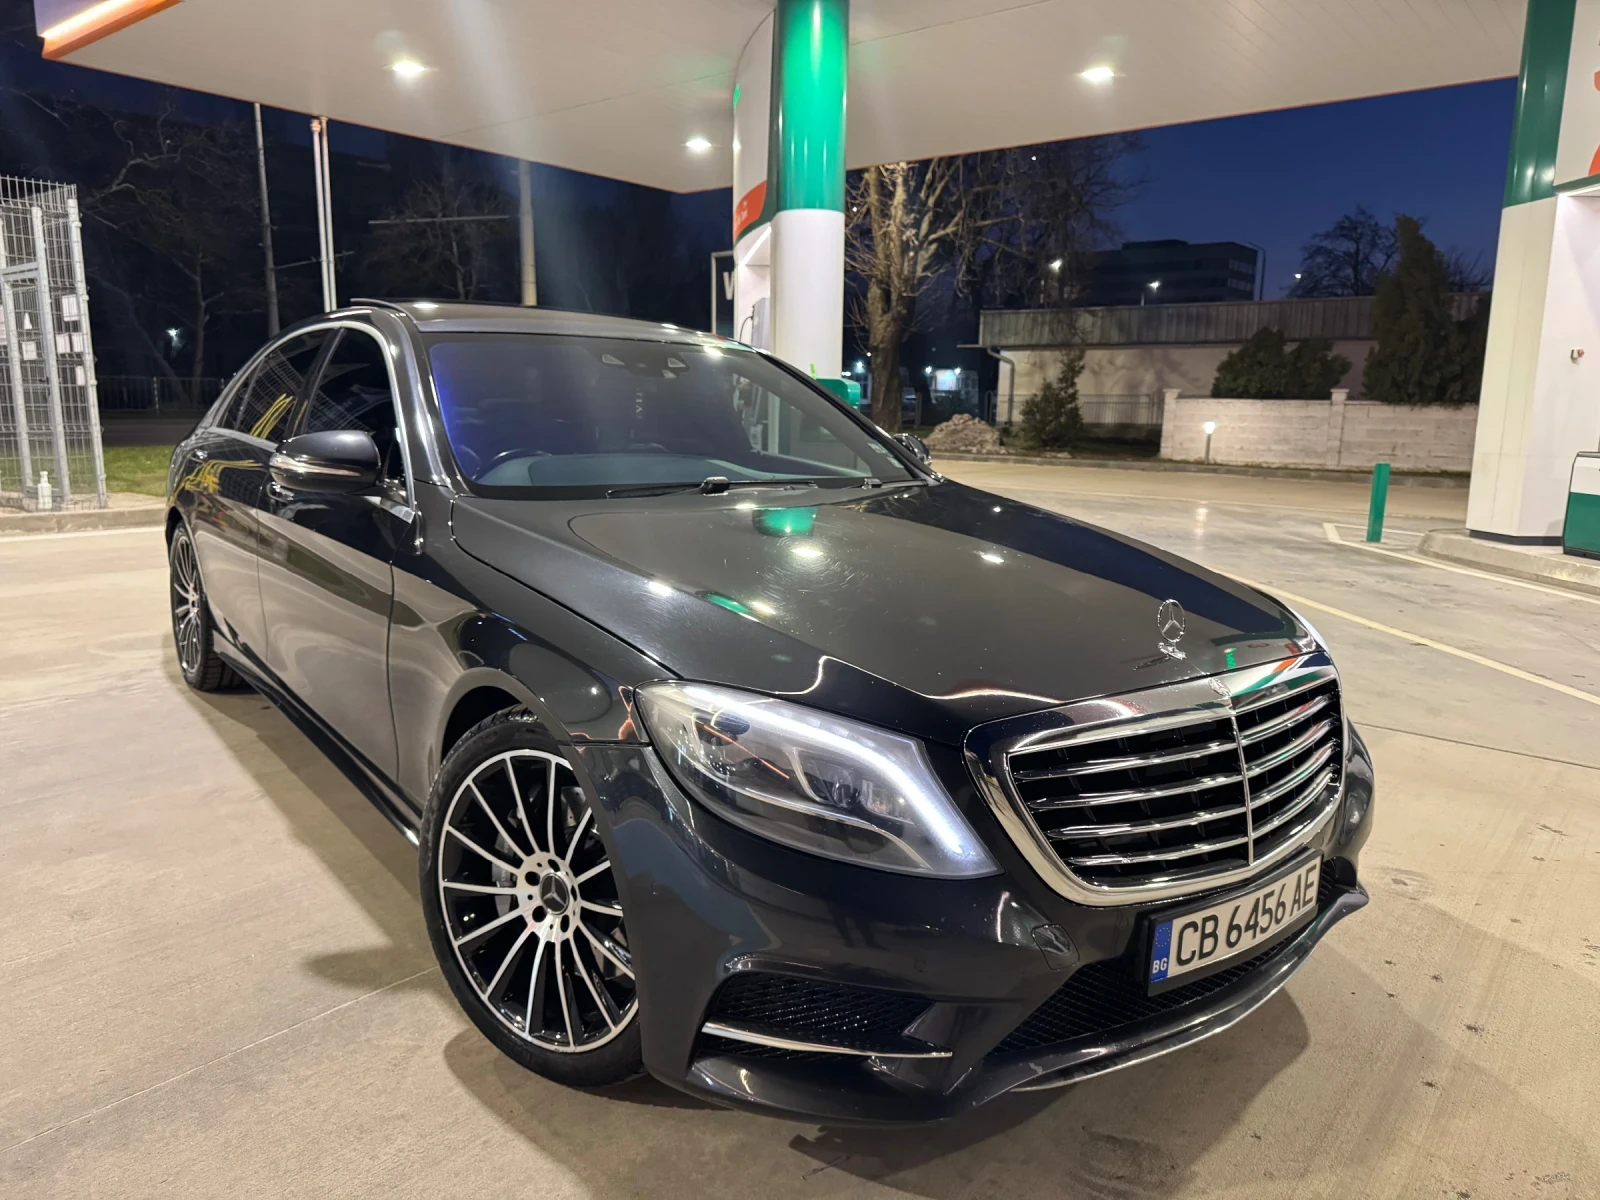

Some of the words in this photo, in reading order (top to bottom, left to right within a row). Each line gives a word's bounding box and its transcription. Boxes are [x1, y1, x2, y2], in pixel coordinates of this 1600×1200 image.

[1176, 914, 1219, 967] CB
[1226, 882, 1287, 948] 6456
[1289, 863, 1318, 917] AE
[1152, 957, 1168, 974] BG
